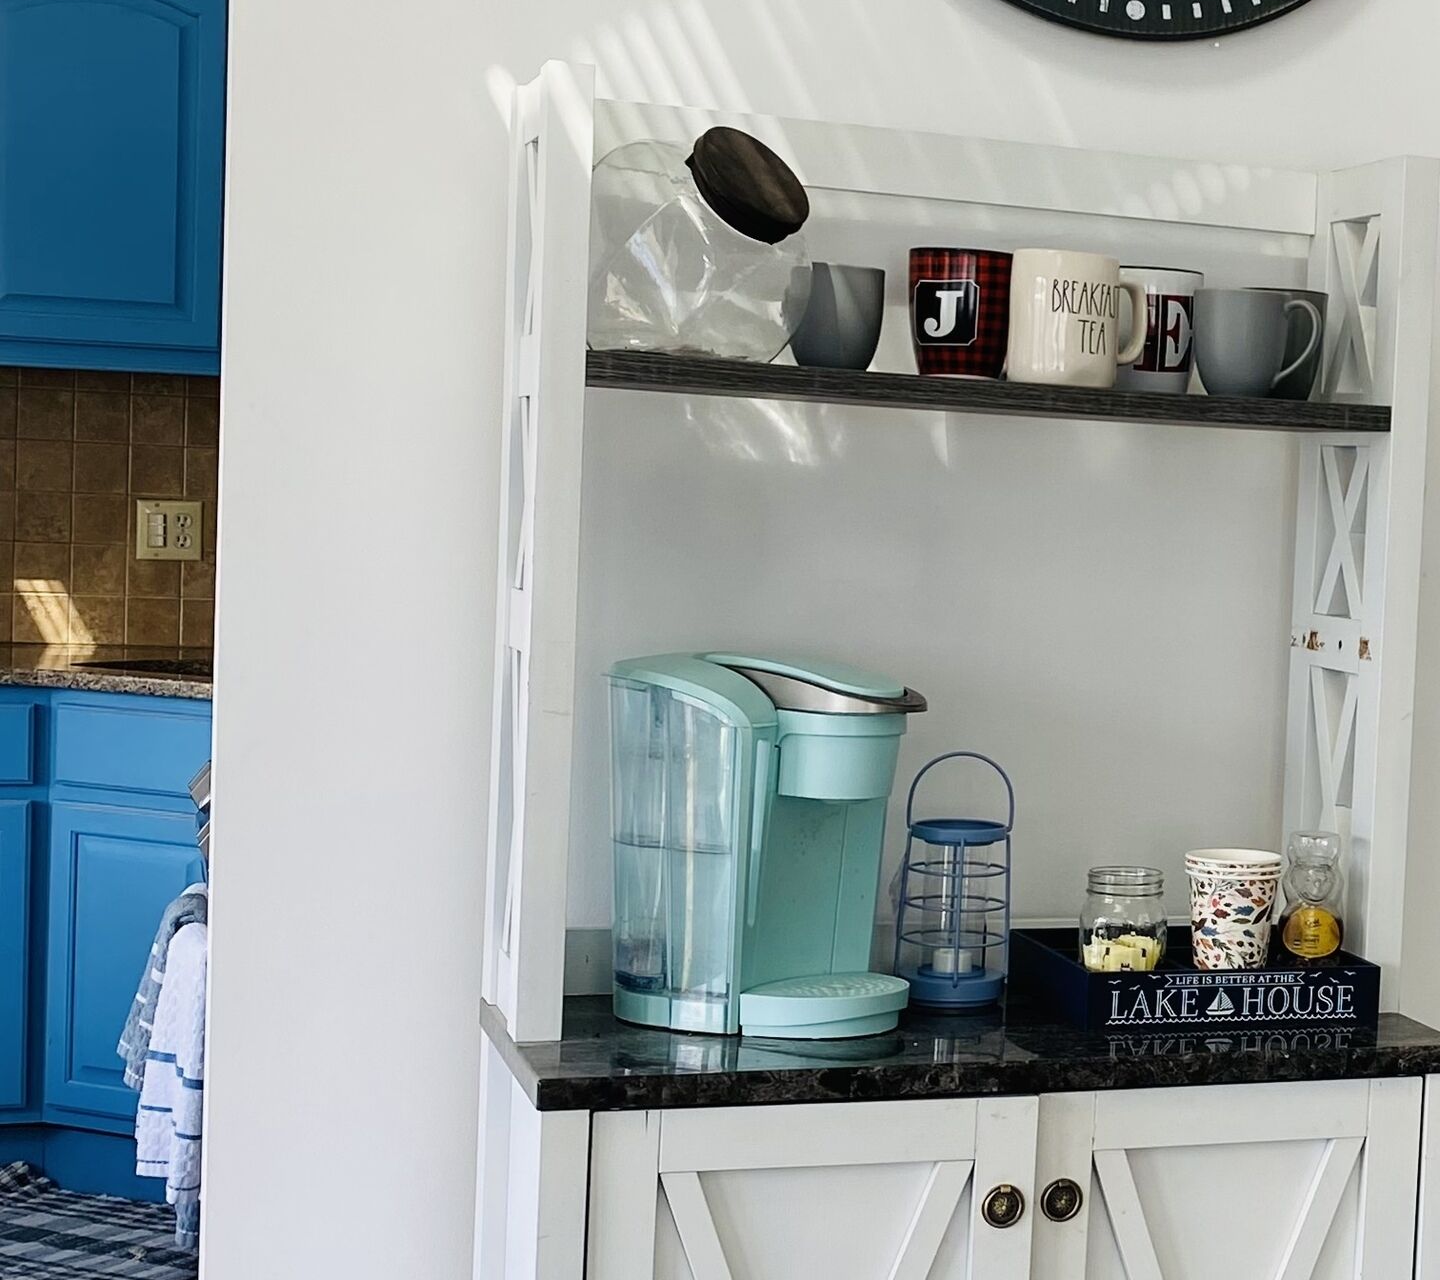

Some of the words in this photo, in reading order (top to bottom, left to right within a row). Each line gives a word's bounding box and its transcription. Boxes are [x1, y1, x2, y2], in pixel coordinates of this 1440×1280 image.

[923, 290, 964, 338] J
[1077, 319, 1106, 356] TEA
[1175, 976, 1200, 985] LIFE
[1202, 976, 1212, 985] IS
[1215, 975, 1256, 984] BETTER
[1258, 975, 1271, 983] AT
[1273, 974, 1295, 983] THE
[1110, 988, 1199, 1019] LAKE
[1241, 985, 1354, 1015] HOUSE
